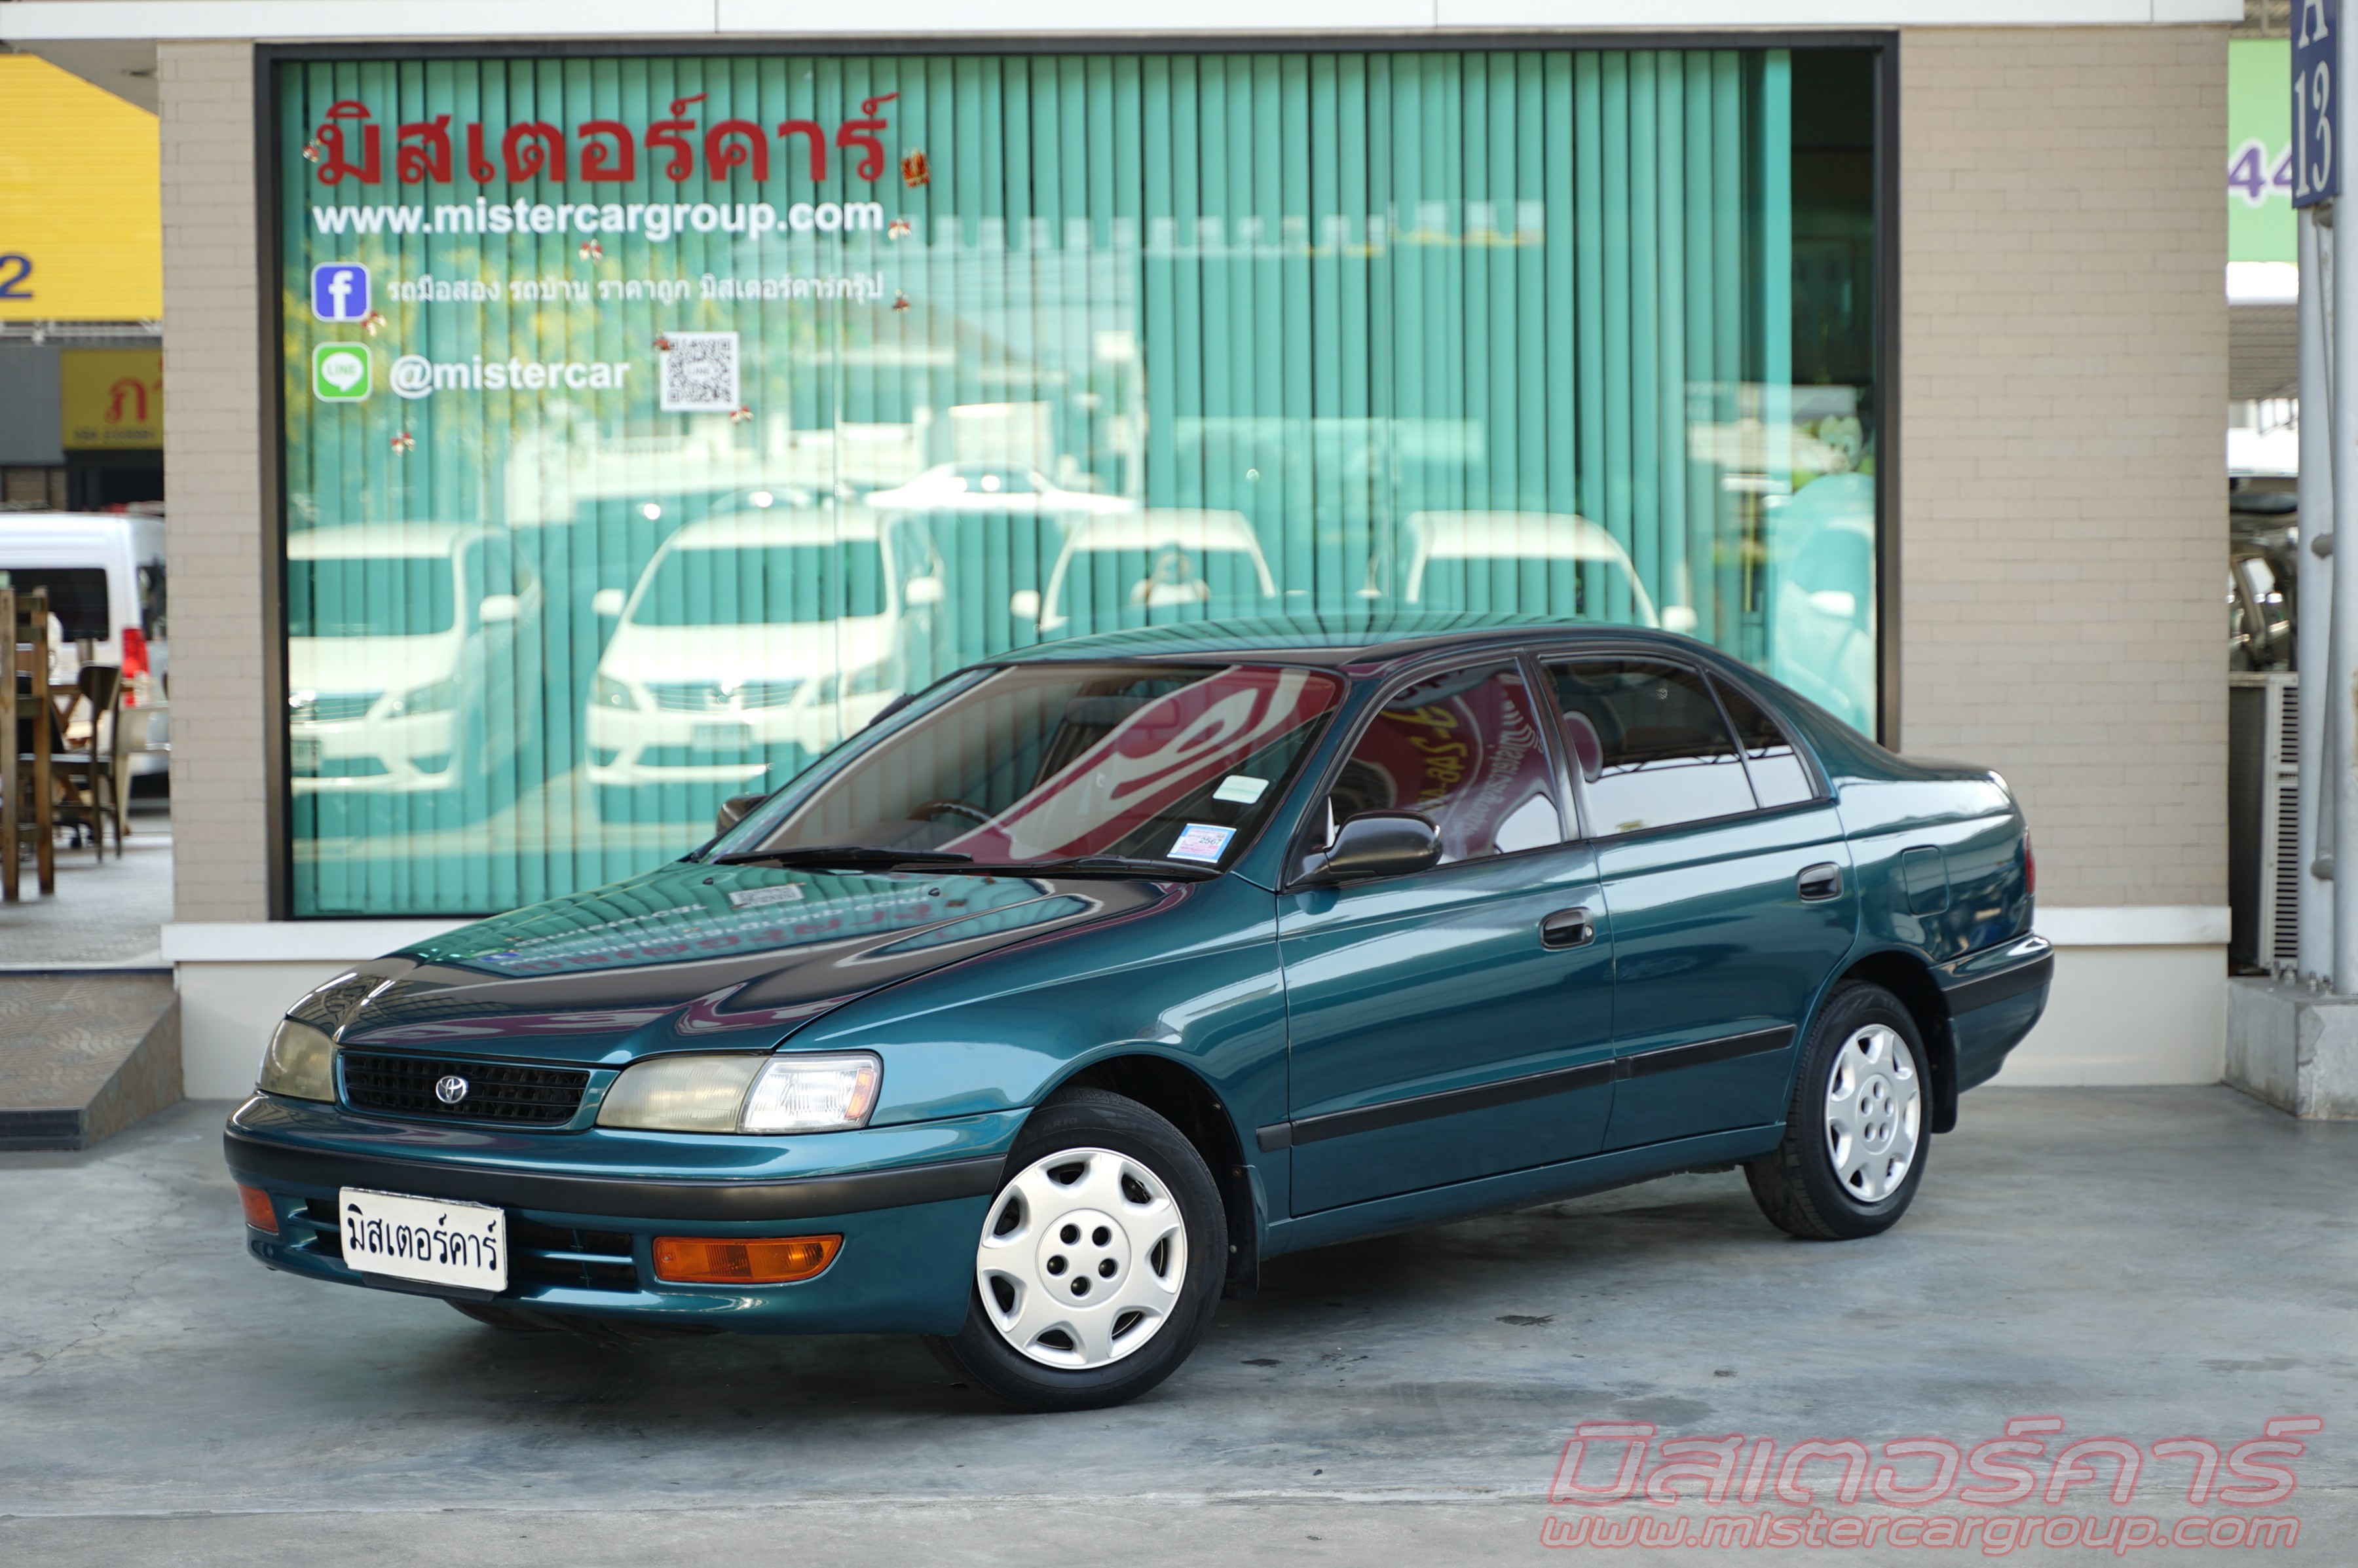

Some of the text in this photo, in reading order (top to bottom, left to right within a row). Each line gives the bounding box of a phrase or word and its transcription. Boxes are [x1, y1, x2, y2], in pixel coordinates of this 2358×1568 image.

[316, 92, 901, 185] มิสเตอร์คาร์
[2294, 60, 2332, 198] 13
[312, 196, 884, 242] www.mistercargroup.com
[387, 274, 500, 302] รถมือสอง
[509, 275, 590, 302] รถบ้าน
[597, 279, 690, 307] ราคาถูก
[328, 364, 356, 377] LINE
[390, 354, 631, 399] @mistercar
[1199, 837, 1222, 846] 2567
[347, 1203, 497, 1271] มิสเตอร์คาร์
